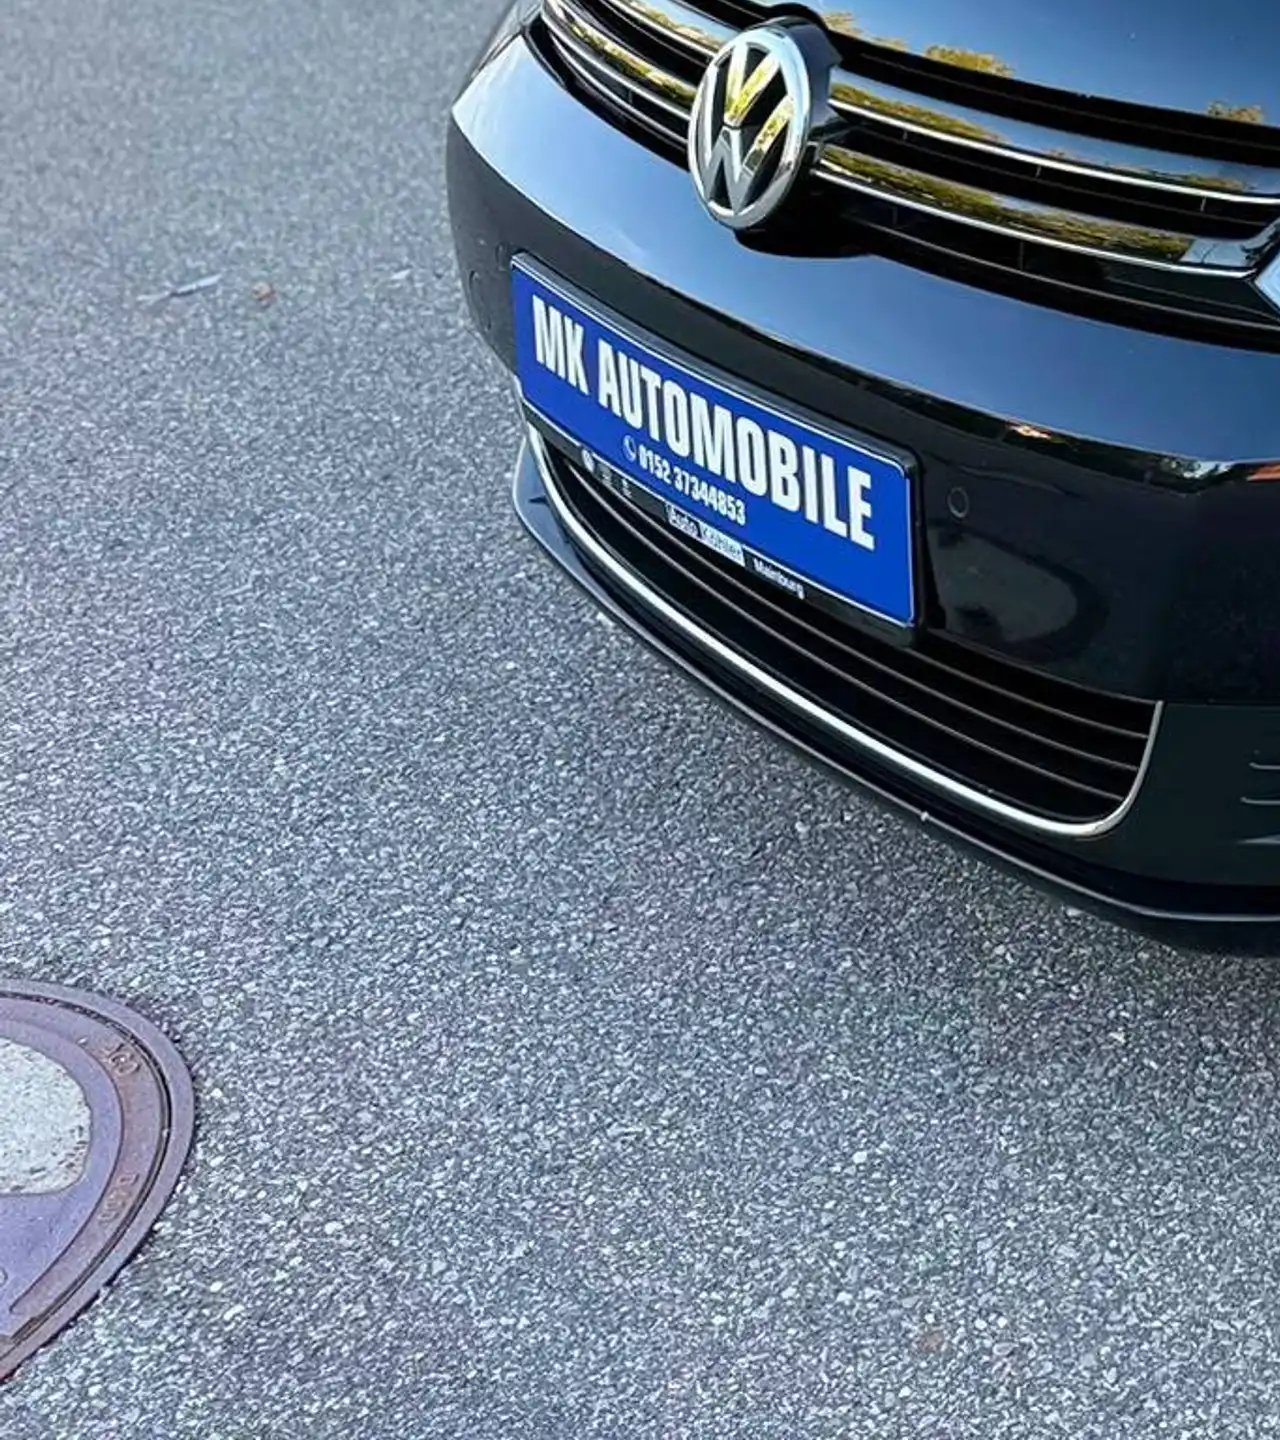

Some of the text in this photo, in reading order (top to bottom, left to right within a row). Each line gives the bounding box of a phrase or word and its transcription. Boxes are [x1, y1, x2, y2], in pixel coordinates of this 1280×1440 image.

[532, 294, 876, 551] MK AUTOMOBILE
[638, 444, 672, 485] 0152
[673, 465, 746, 527] 37344853
